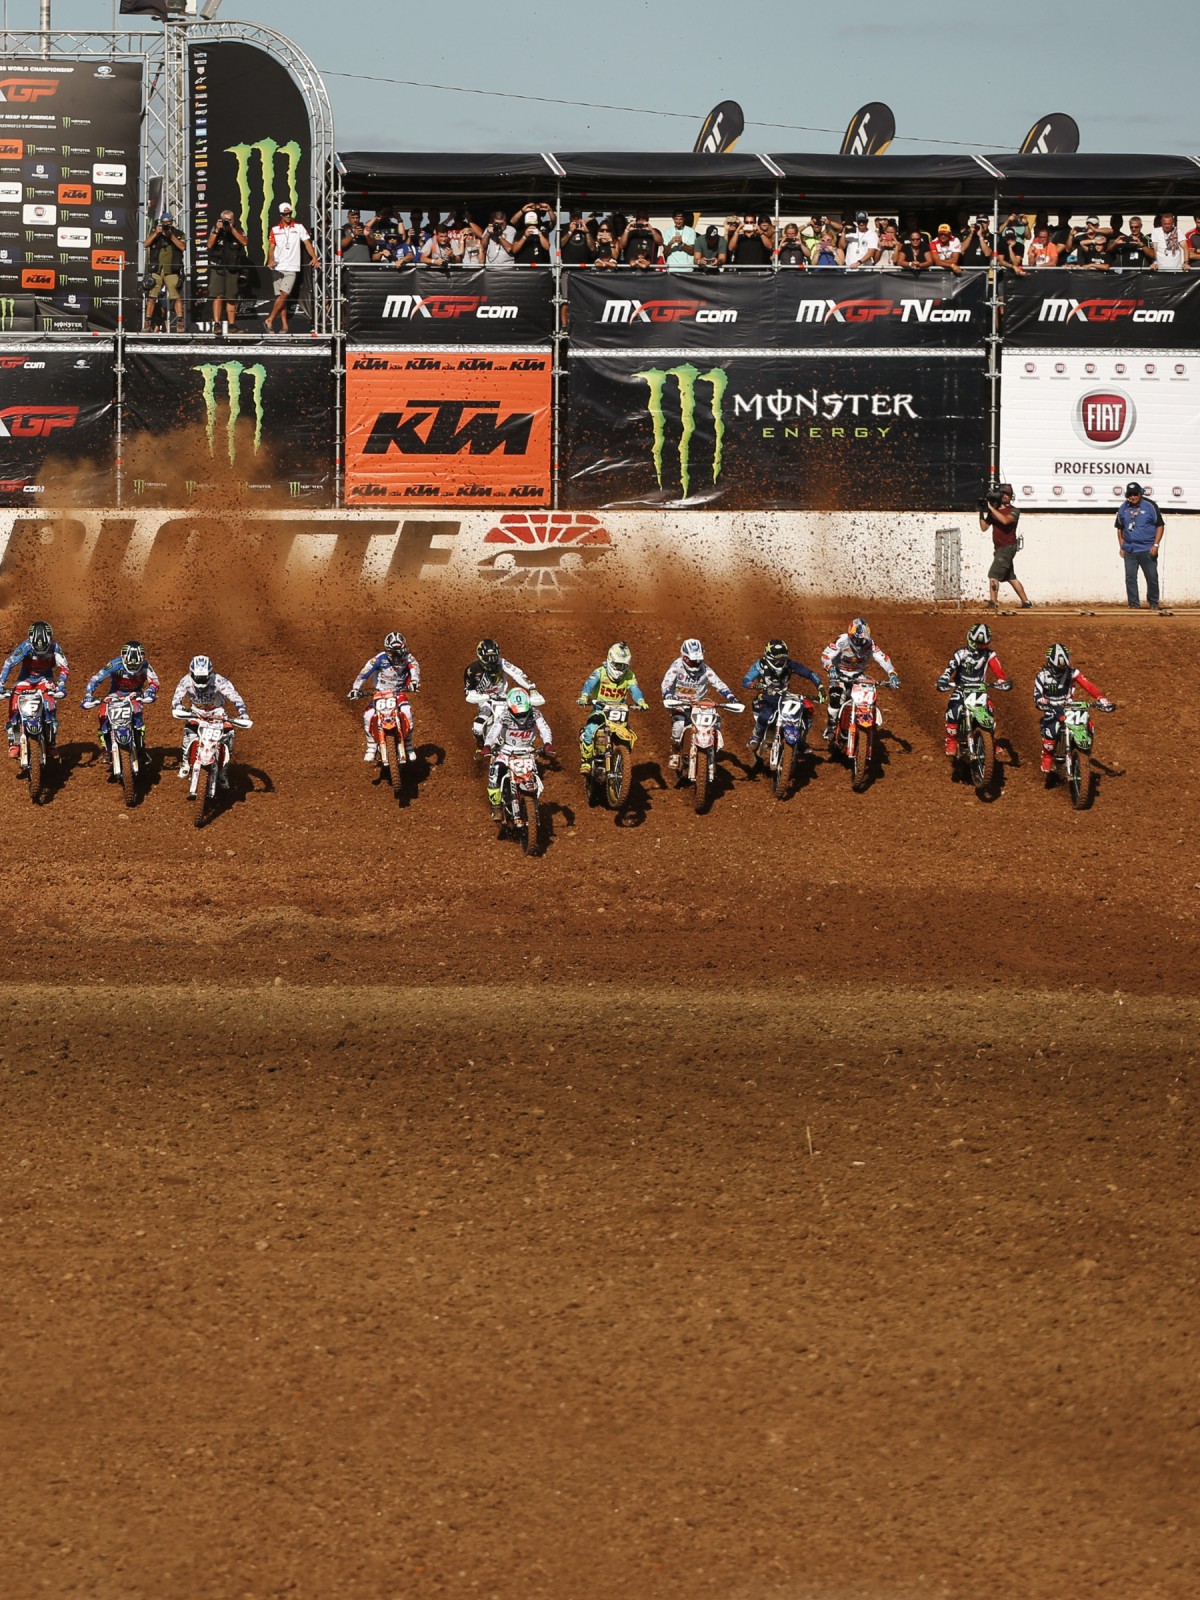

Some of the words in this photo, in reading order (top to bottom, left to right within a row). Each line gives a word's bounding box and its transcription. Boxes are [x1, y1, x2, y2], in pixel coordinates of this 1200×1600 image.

[733, 388, 918, 422] MONSTER
[1088, 404, 1122, 431] FIAT
[362, 400, 535, 455] KTM
[763, 426, 892, 438] ENERGY
[1054, 462, 1152, 475] PROFESSIONAL
[376, 698, 396, 710] 66
[964, 692, 988, 706] 44
[110, 708, 131, 719] 172
[781, 701, 802, 715] 17
[608, 711, 626, 722] 91
[696, 715, 712, 725] 10
[1065, 711, 1088, 724] 214
